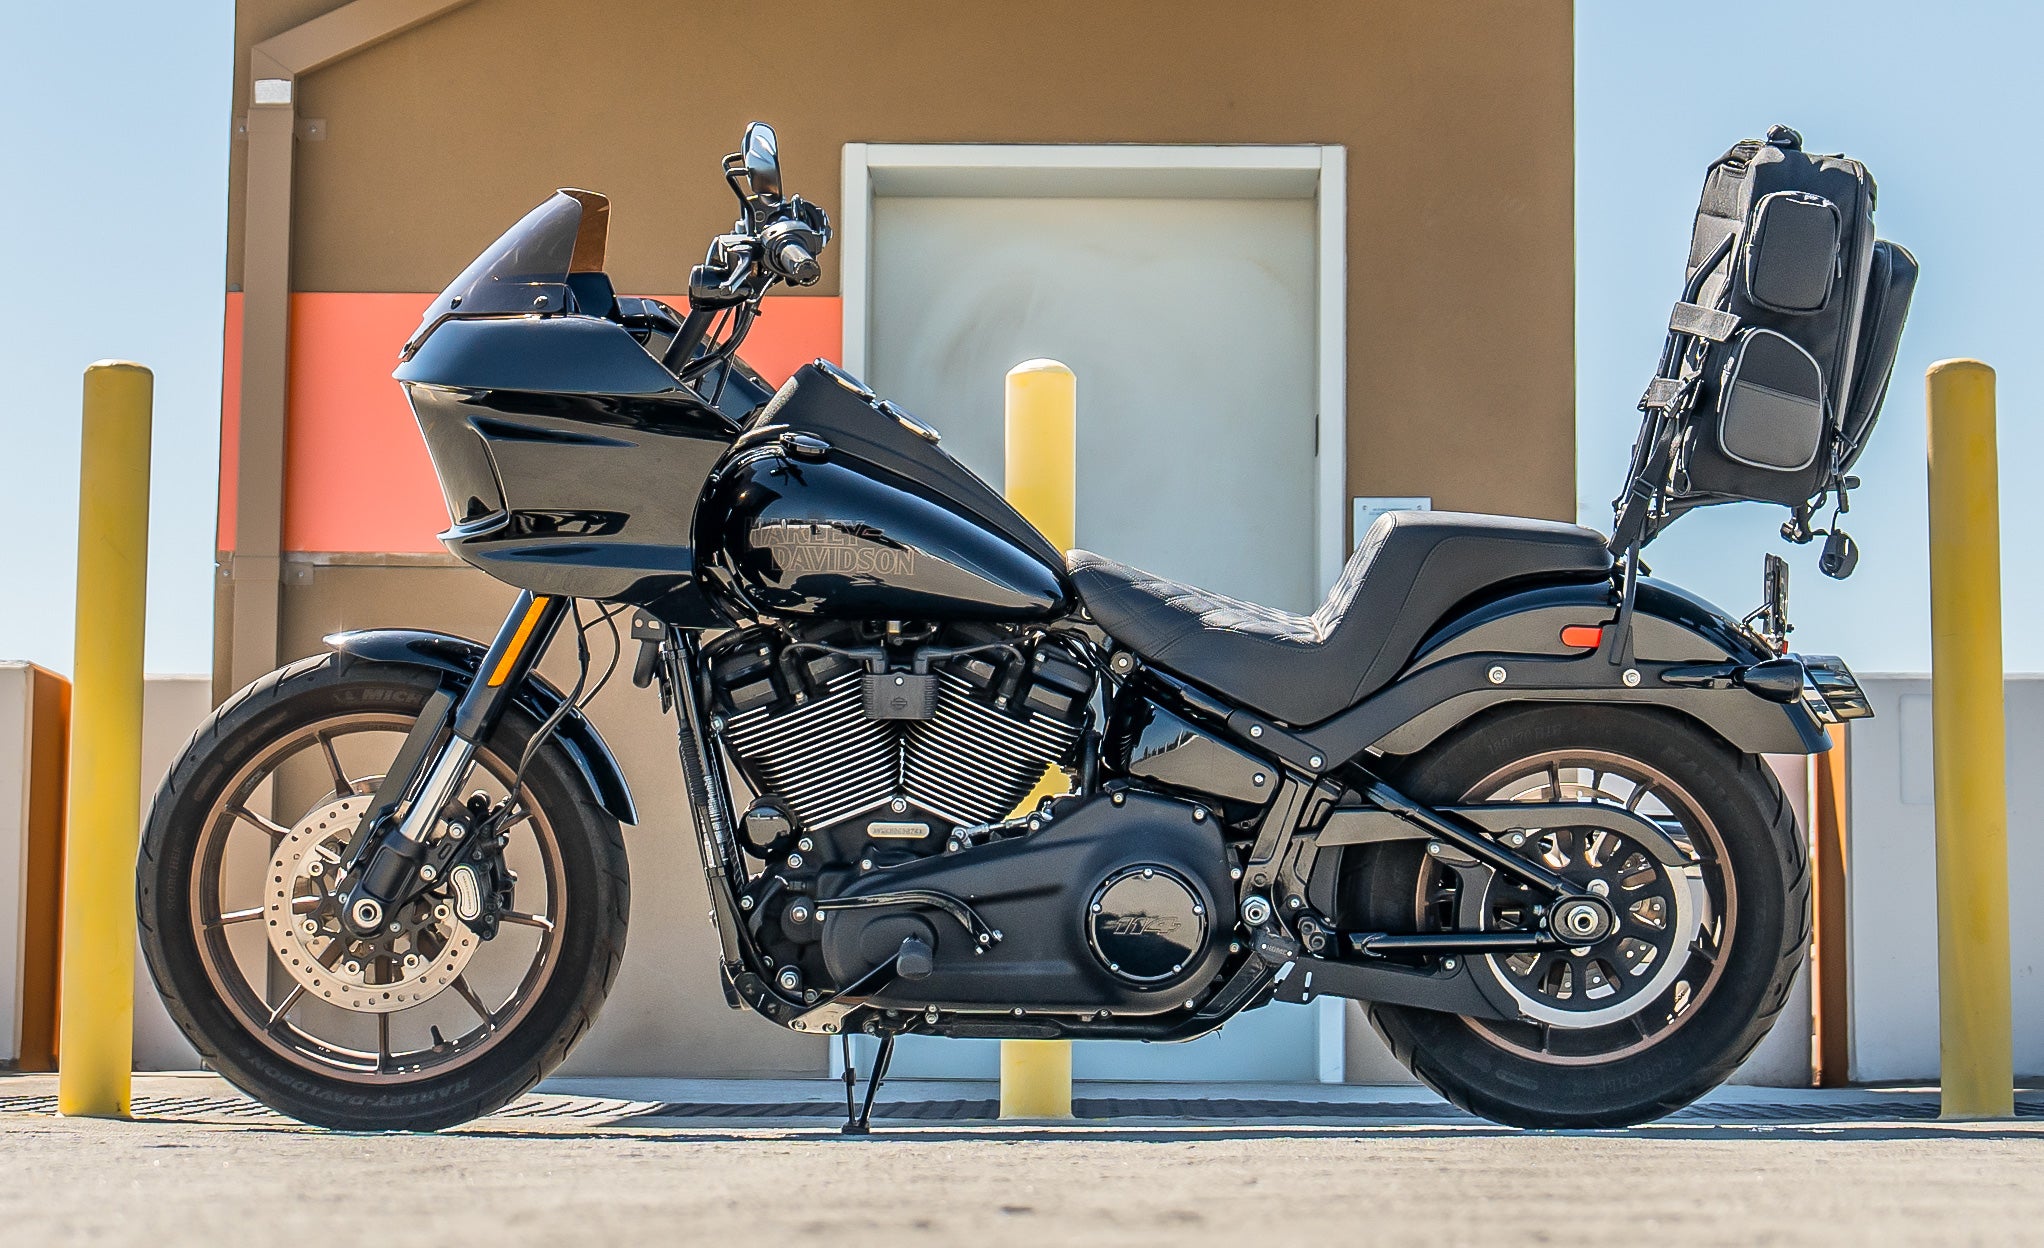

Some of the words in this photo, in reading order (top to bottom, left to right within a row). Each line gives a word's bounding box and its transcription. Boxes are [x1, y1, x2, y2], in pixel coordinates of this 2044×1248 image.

[744, 517, 866, 549] HARLEY
[771, 545, 916, 576] DAVIDSON
[1113, 915, 1182, 935] 114
